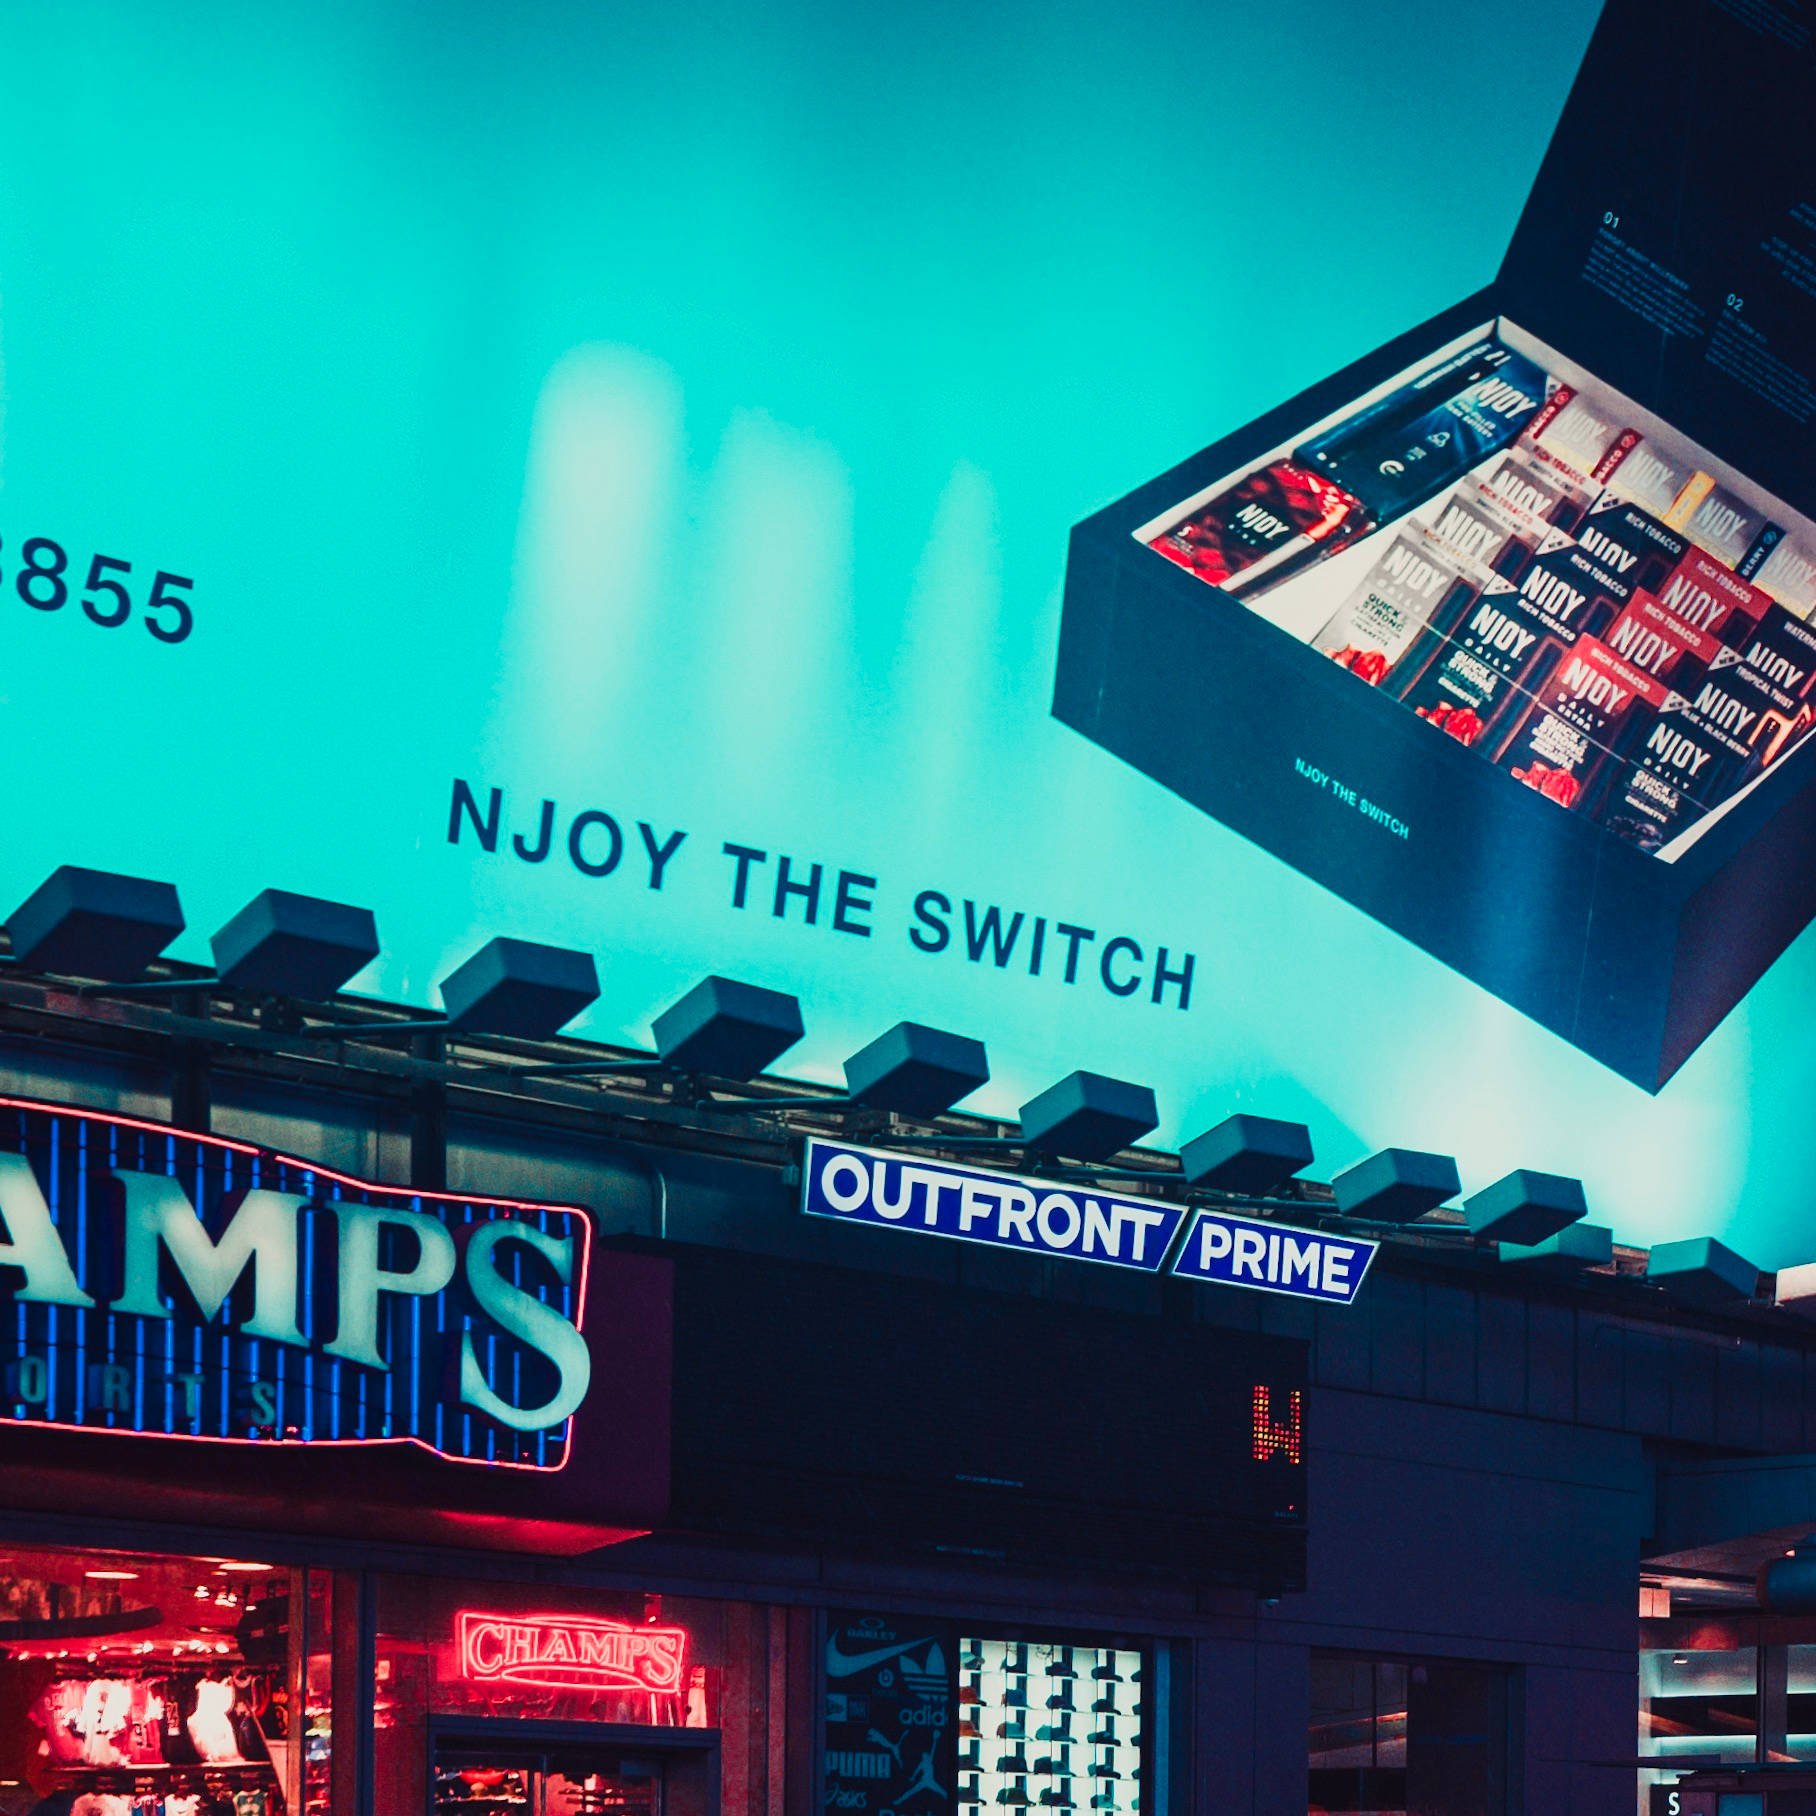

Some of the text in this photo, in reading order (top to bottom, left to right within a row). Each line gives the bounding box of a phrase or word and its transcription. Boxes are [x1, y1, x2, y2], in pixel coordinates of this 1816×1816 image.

[1602, 210, 1620, 229] 01
[1726, 293, 1744, 312] 02
[1472, 377, 1537, 419] NJOY
[1235, 503, 1290, 539] NJOY
[1435, 504, 1503, 562] NJOY
[1625, 511, 1682, 555] RICH TOBACCO
[1697, 497, 1747, 543] NJOY
[0, 534, 194, 645] 855
[1383, 545, 1449, 598] NJOY
[1520, 565, 1586, 622] NJOY
[1570, 553, 1628, 598] RICH TOBACCO
[1696, 560, 1752, 604] RICH TOBACCO
[1361, 601, 1405, 633] STRONG
[1368, 593, 1400, 618] QUICK
[1517, 599, 1577, 642] RICH TOBACCO
[1644, 603, 1701, 647] RICH TOBACCO
[1469, 603, 1537, 659] NJOY
[1610, 616, 1678, 674] NJOY
[1562, 656, 1628, 714] NJOY
[1612, 661, 1650, 693] TOBACCO
[1735, 665, 1796, 711] TROPICAL TWIST
[1647, 722, 1711, 777] NJOY
[1295, 757, 1410, 840] NJOY THE SWITCH
[1635, 769, 1671, 797] QUICK
[447, 779, 1197, 1011] NJOY THE SWITCH
[821, 1153, 1355, 1295] OUTFRONT PRIME
[16, 1354, 278, 1427] ORTS
[468, 1623, 679, 1685] CHAMPS
